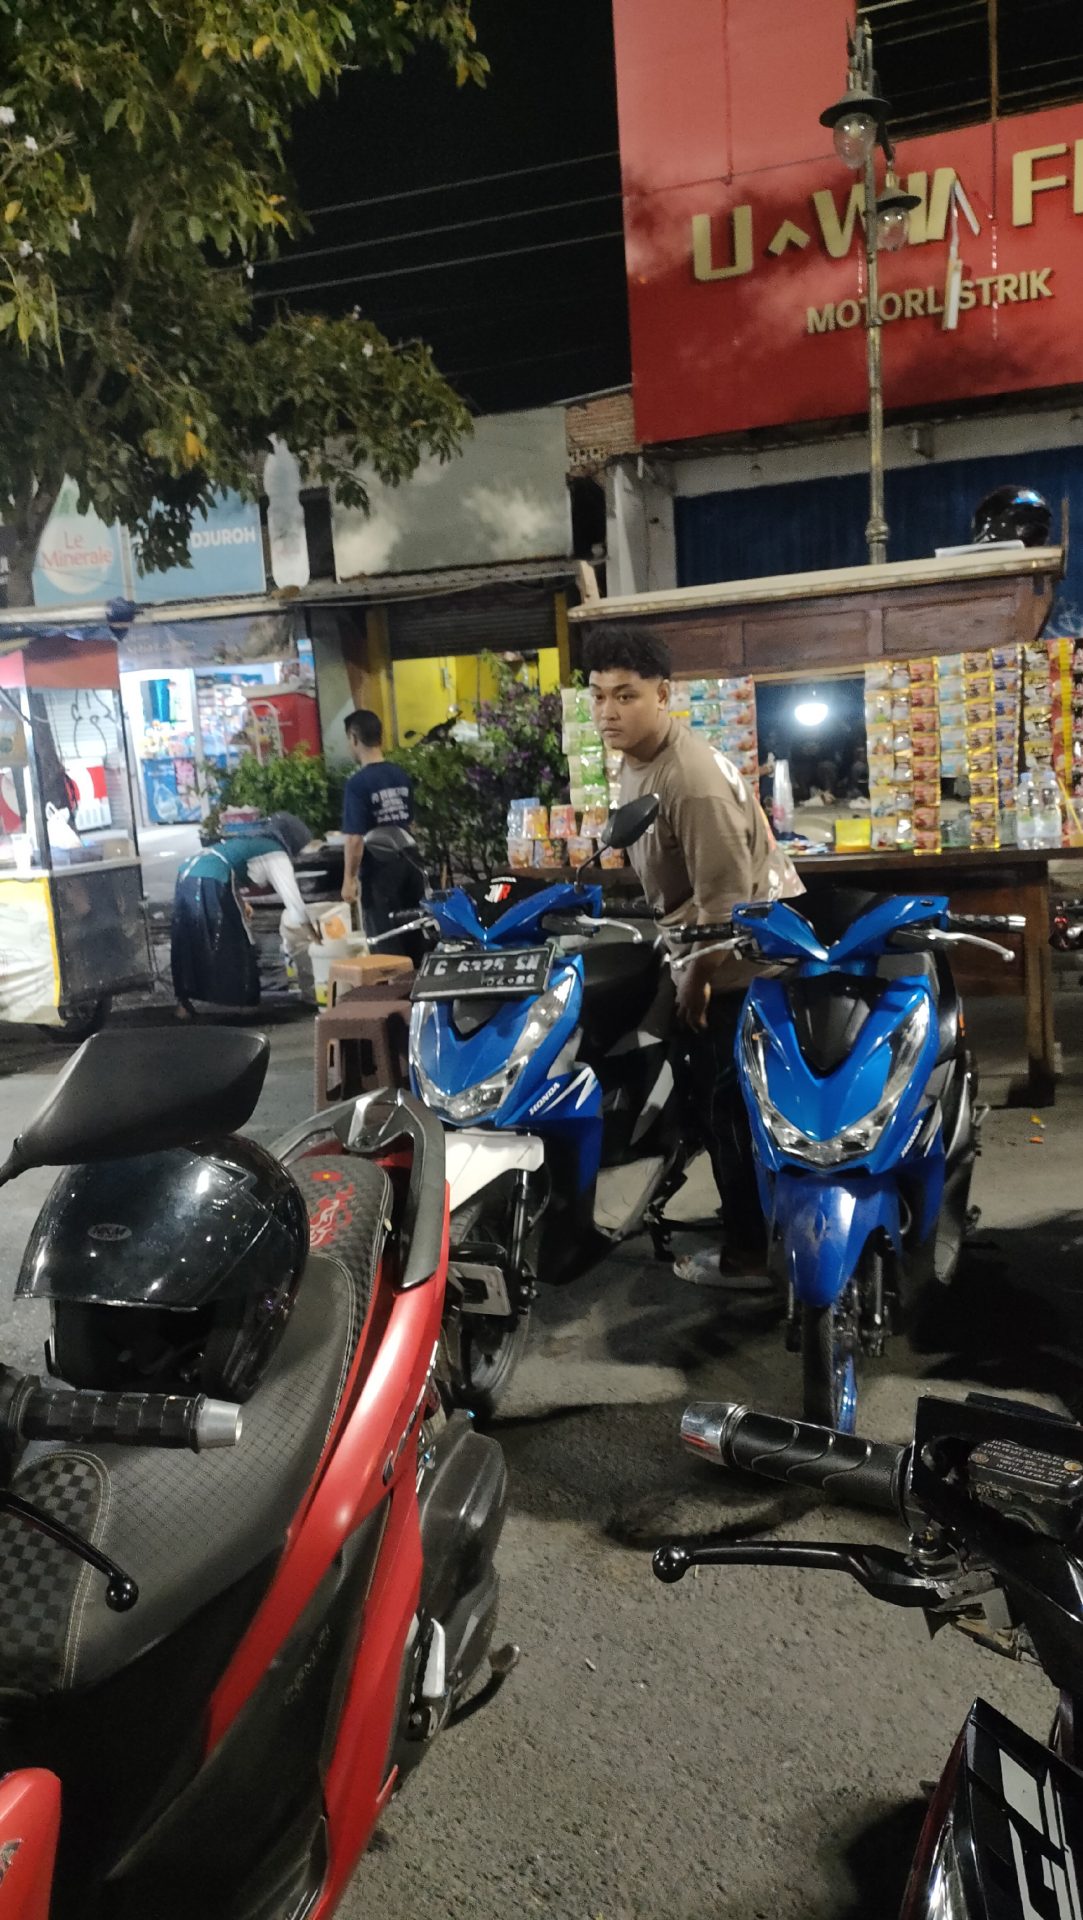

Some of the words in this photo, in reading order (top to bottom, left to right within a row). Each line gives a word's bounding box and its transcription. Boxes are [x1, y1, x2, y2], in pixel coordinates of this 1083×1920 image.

[64, 530, 85, 549] Le
[41, 546, 114, 571] Minerale
[529, 1082, 560, 1116] HONDA
